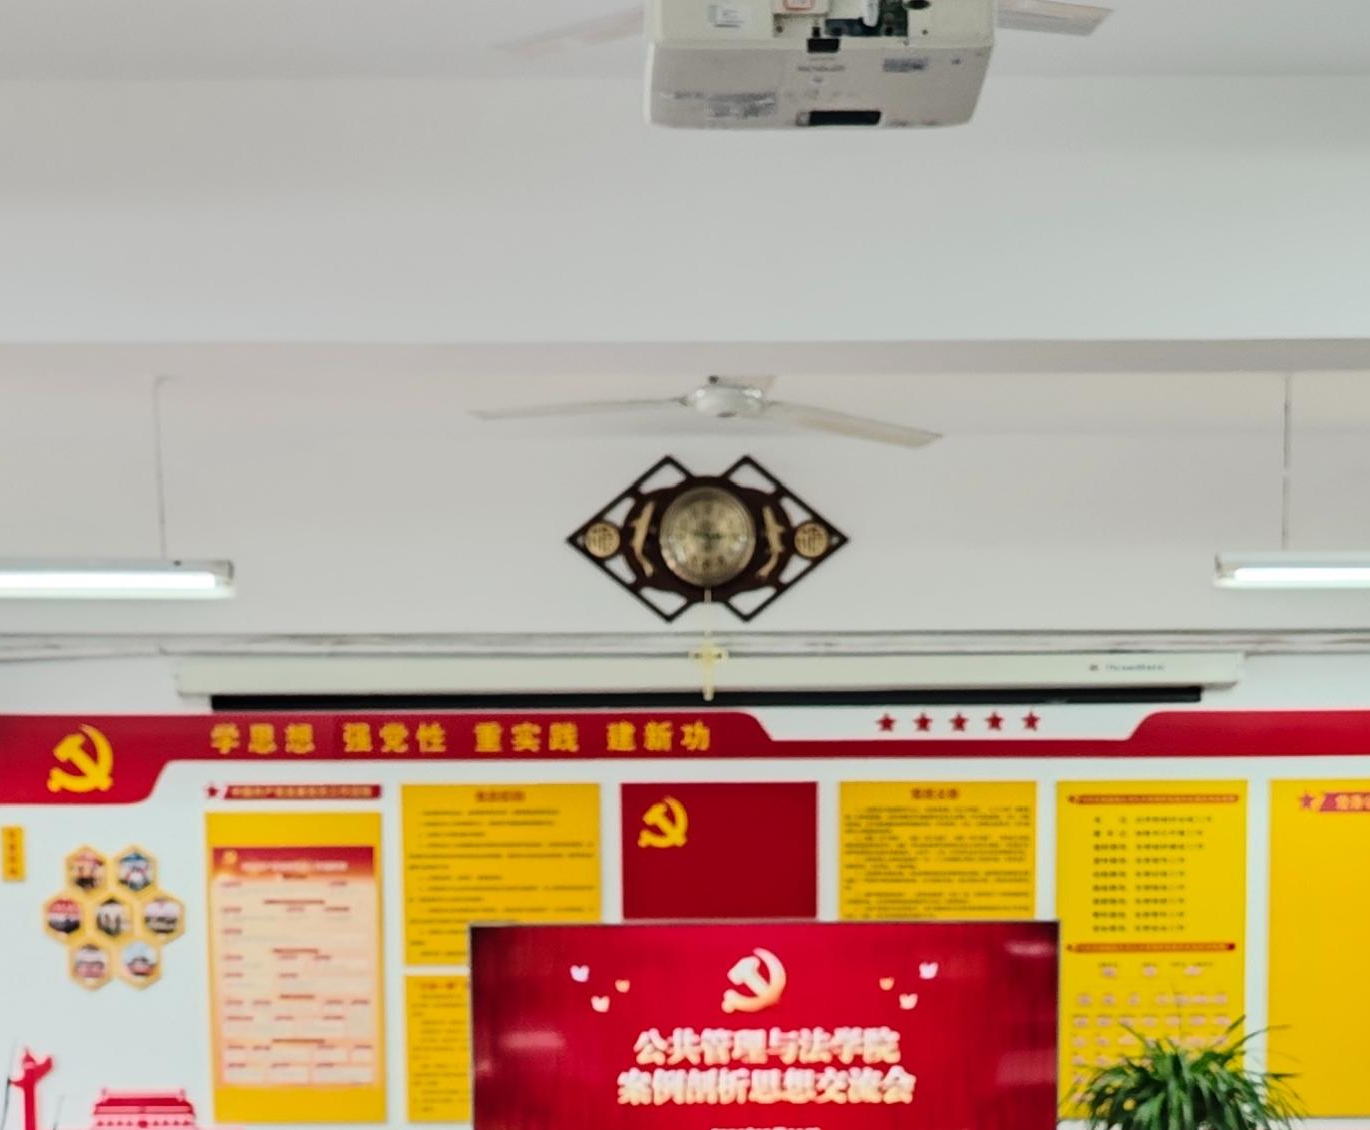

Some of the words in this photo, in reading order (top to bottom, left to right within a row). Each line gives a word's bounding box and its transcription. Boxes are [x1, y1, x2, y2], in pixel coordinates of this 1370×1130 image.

[211, 722, 315, 754] 学思想
[343, 721, 446, 753] 强党性
[475, 721, 579, 753] 重实践
[607, 720, 711, 751] 建新功
[633, 1026, 901, 1065] 公共管理与法学院
[617, 1065, 917, 1105] 案例剖析思想交流会
